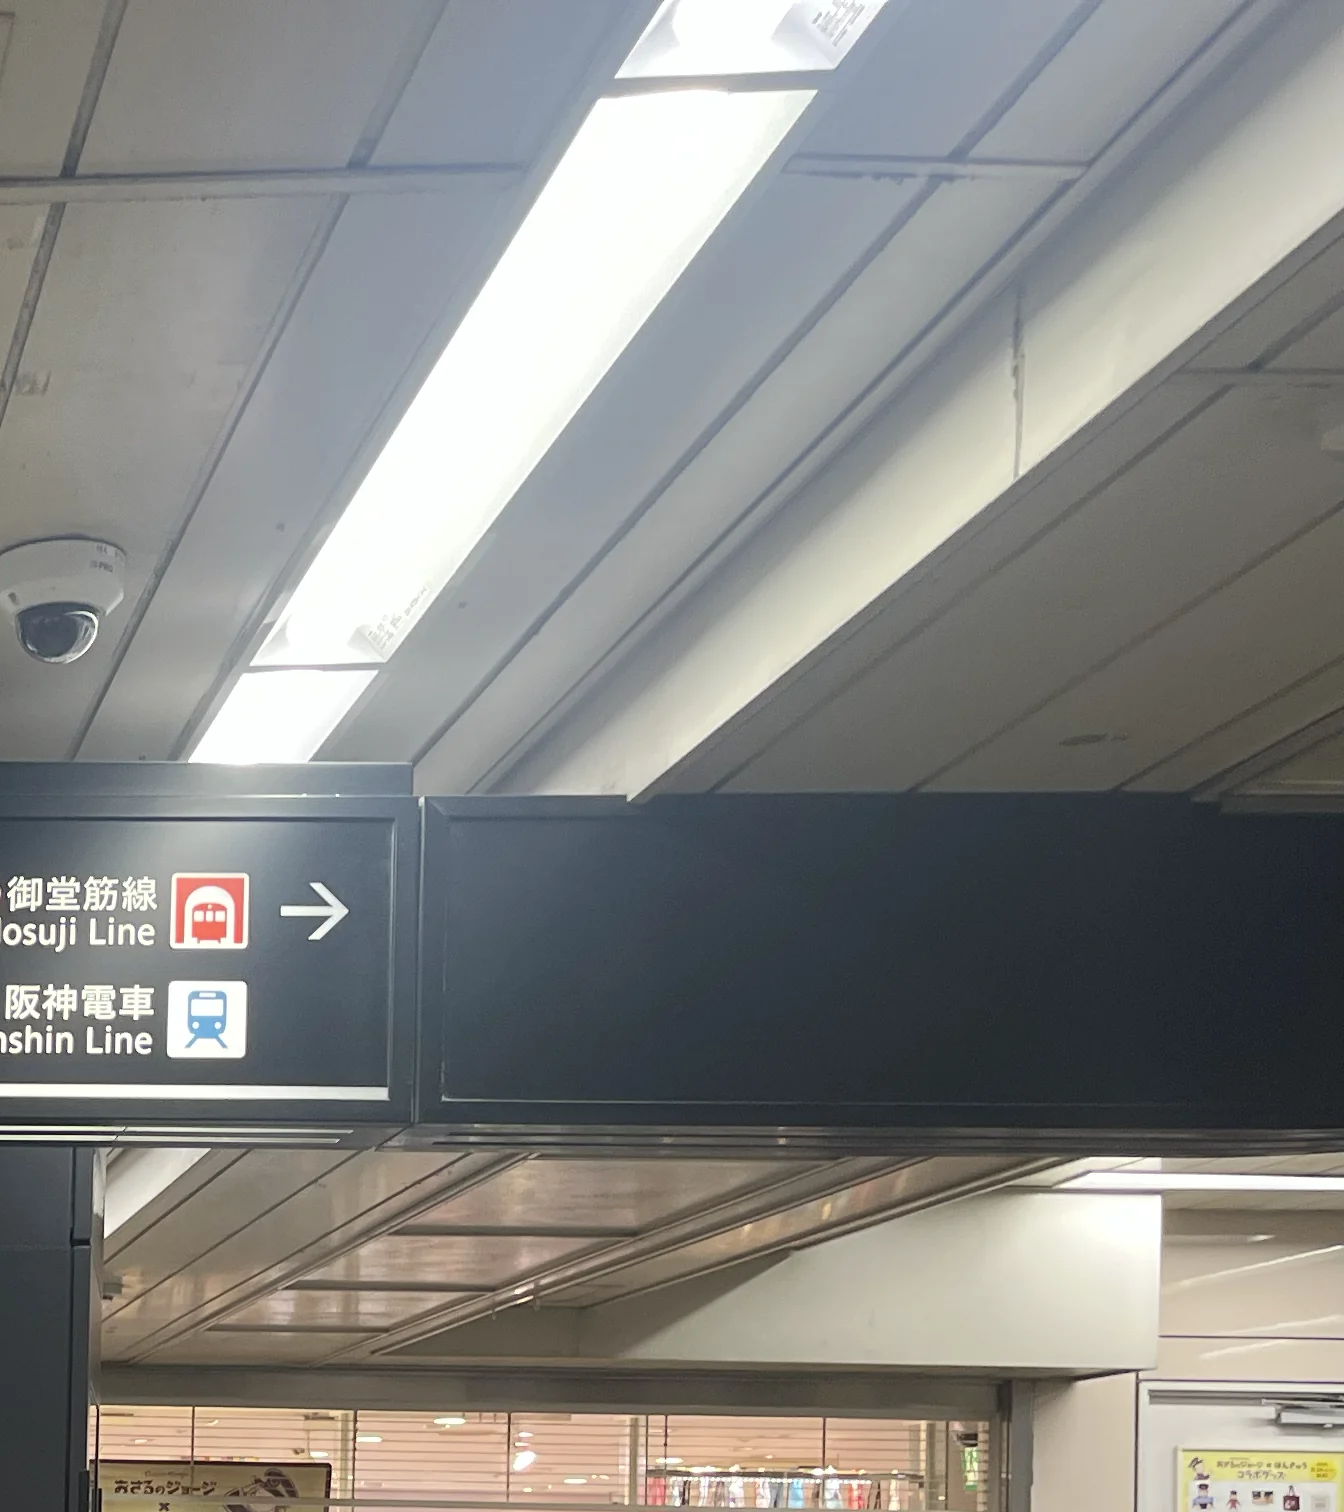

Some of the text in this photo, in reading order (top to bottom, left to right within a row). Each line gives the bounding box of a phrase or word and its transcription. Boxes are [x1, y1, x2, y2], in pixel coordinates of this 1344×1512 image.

[6, 875, 159, 912] 御堂筋線
[89, 916, 156, 946] Line
[4, 983, 156, 1021] 阪神電車
[86, 1024, 153, 1055] Line
[114, 1479, 217, 1496] おさるのジョージ
